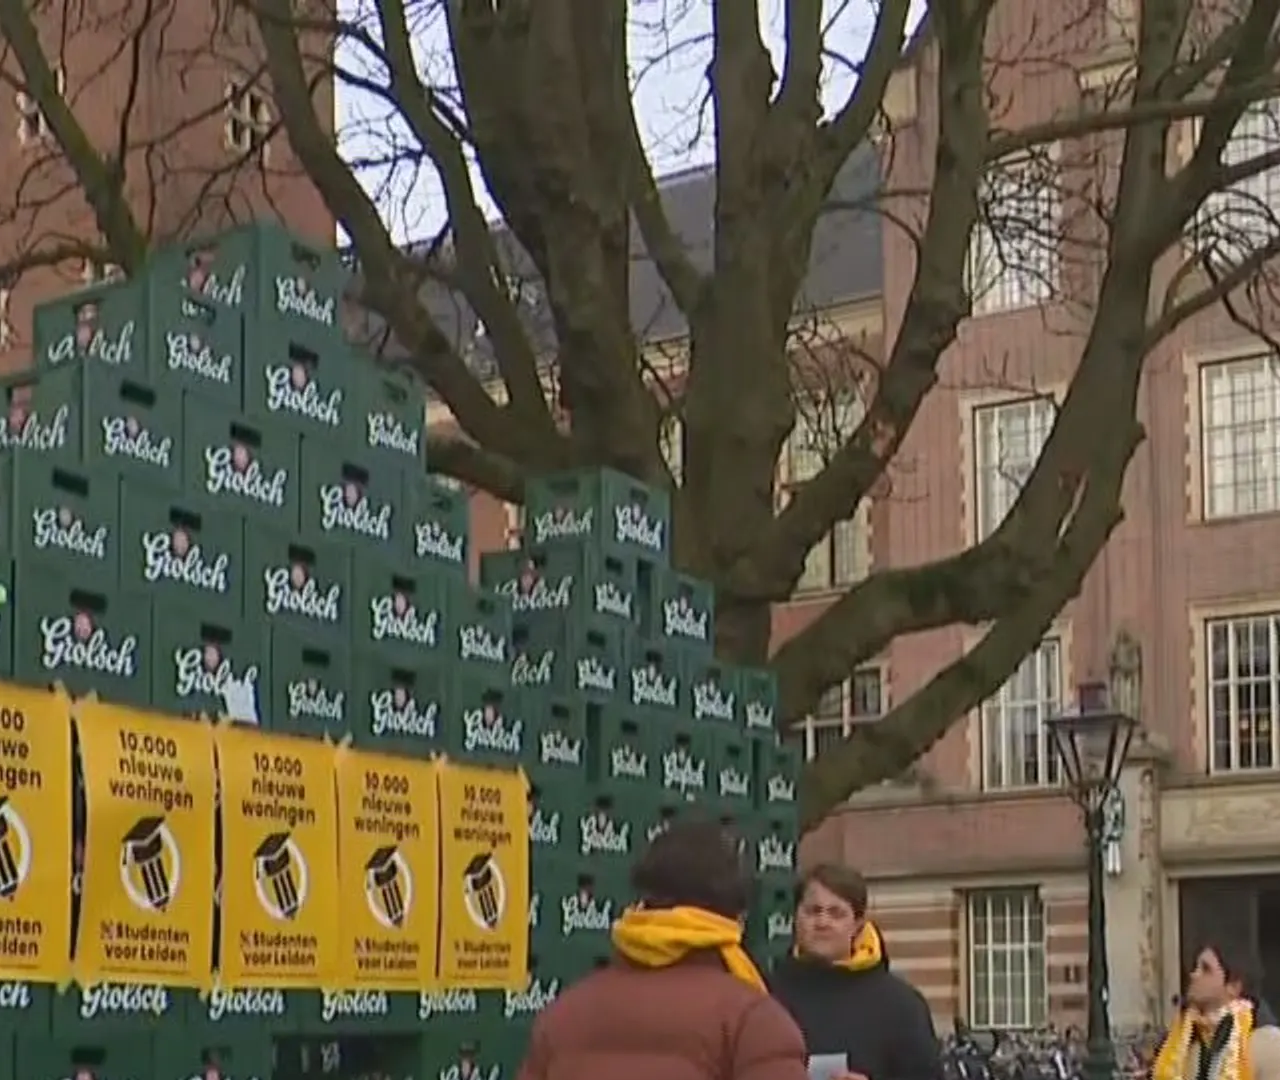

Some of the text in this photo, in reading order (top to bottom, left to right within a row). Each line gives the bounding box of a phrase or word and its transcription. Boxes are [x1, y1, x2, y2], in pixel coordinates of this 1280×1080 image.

[167, 332, 231, 383] Grolsch
[266, 365, 341, 425] Grolsch
[103, 417, 171, 467] Grolsch
[206, 445, 286, 506] Grolsch
[321, 484, 390, 539] Grolsch
[33, 508, 106, 558] Grolsch
[143, 531, 227, 592] Grolsch
[265, 566, 339, 620] Grolsch
[372, 593, 436, 645] Grolsch
[41, 617, 135, 676] Grolsch
[372, 688, 436, 737] Grolsch
[118, 729, 177, 758] 10.000
[119, 756, 184, 783] nieuwe
[253, 752, 303, 776] 10.000
[109, 778, 193, 812] woningen
[252, 775, 306, 800] nieuwe
[364, 771, 409, 795] 10.000
[241, 798, 316, 828] woningen
[362, 794, 412, 817] nieuwe
[354, 816, 420, 842] woningen
[115, 921, 190, 945] Studenten
[253, 929, 318, 949] Studenten
[104, 943, 187, 962] voor Leiden
[243, 951, 316, 968] voor Leiden
